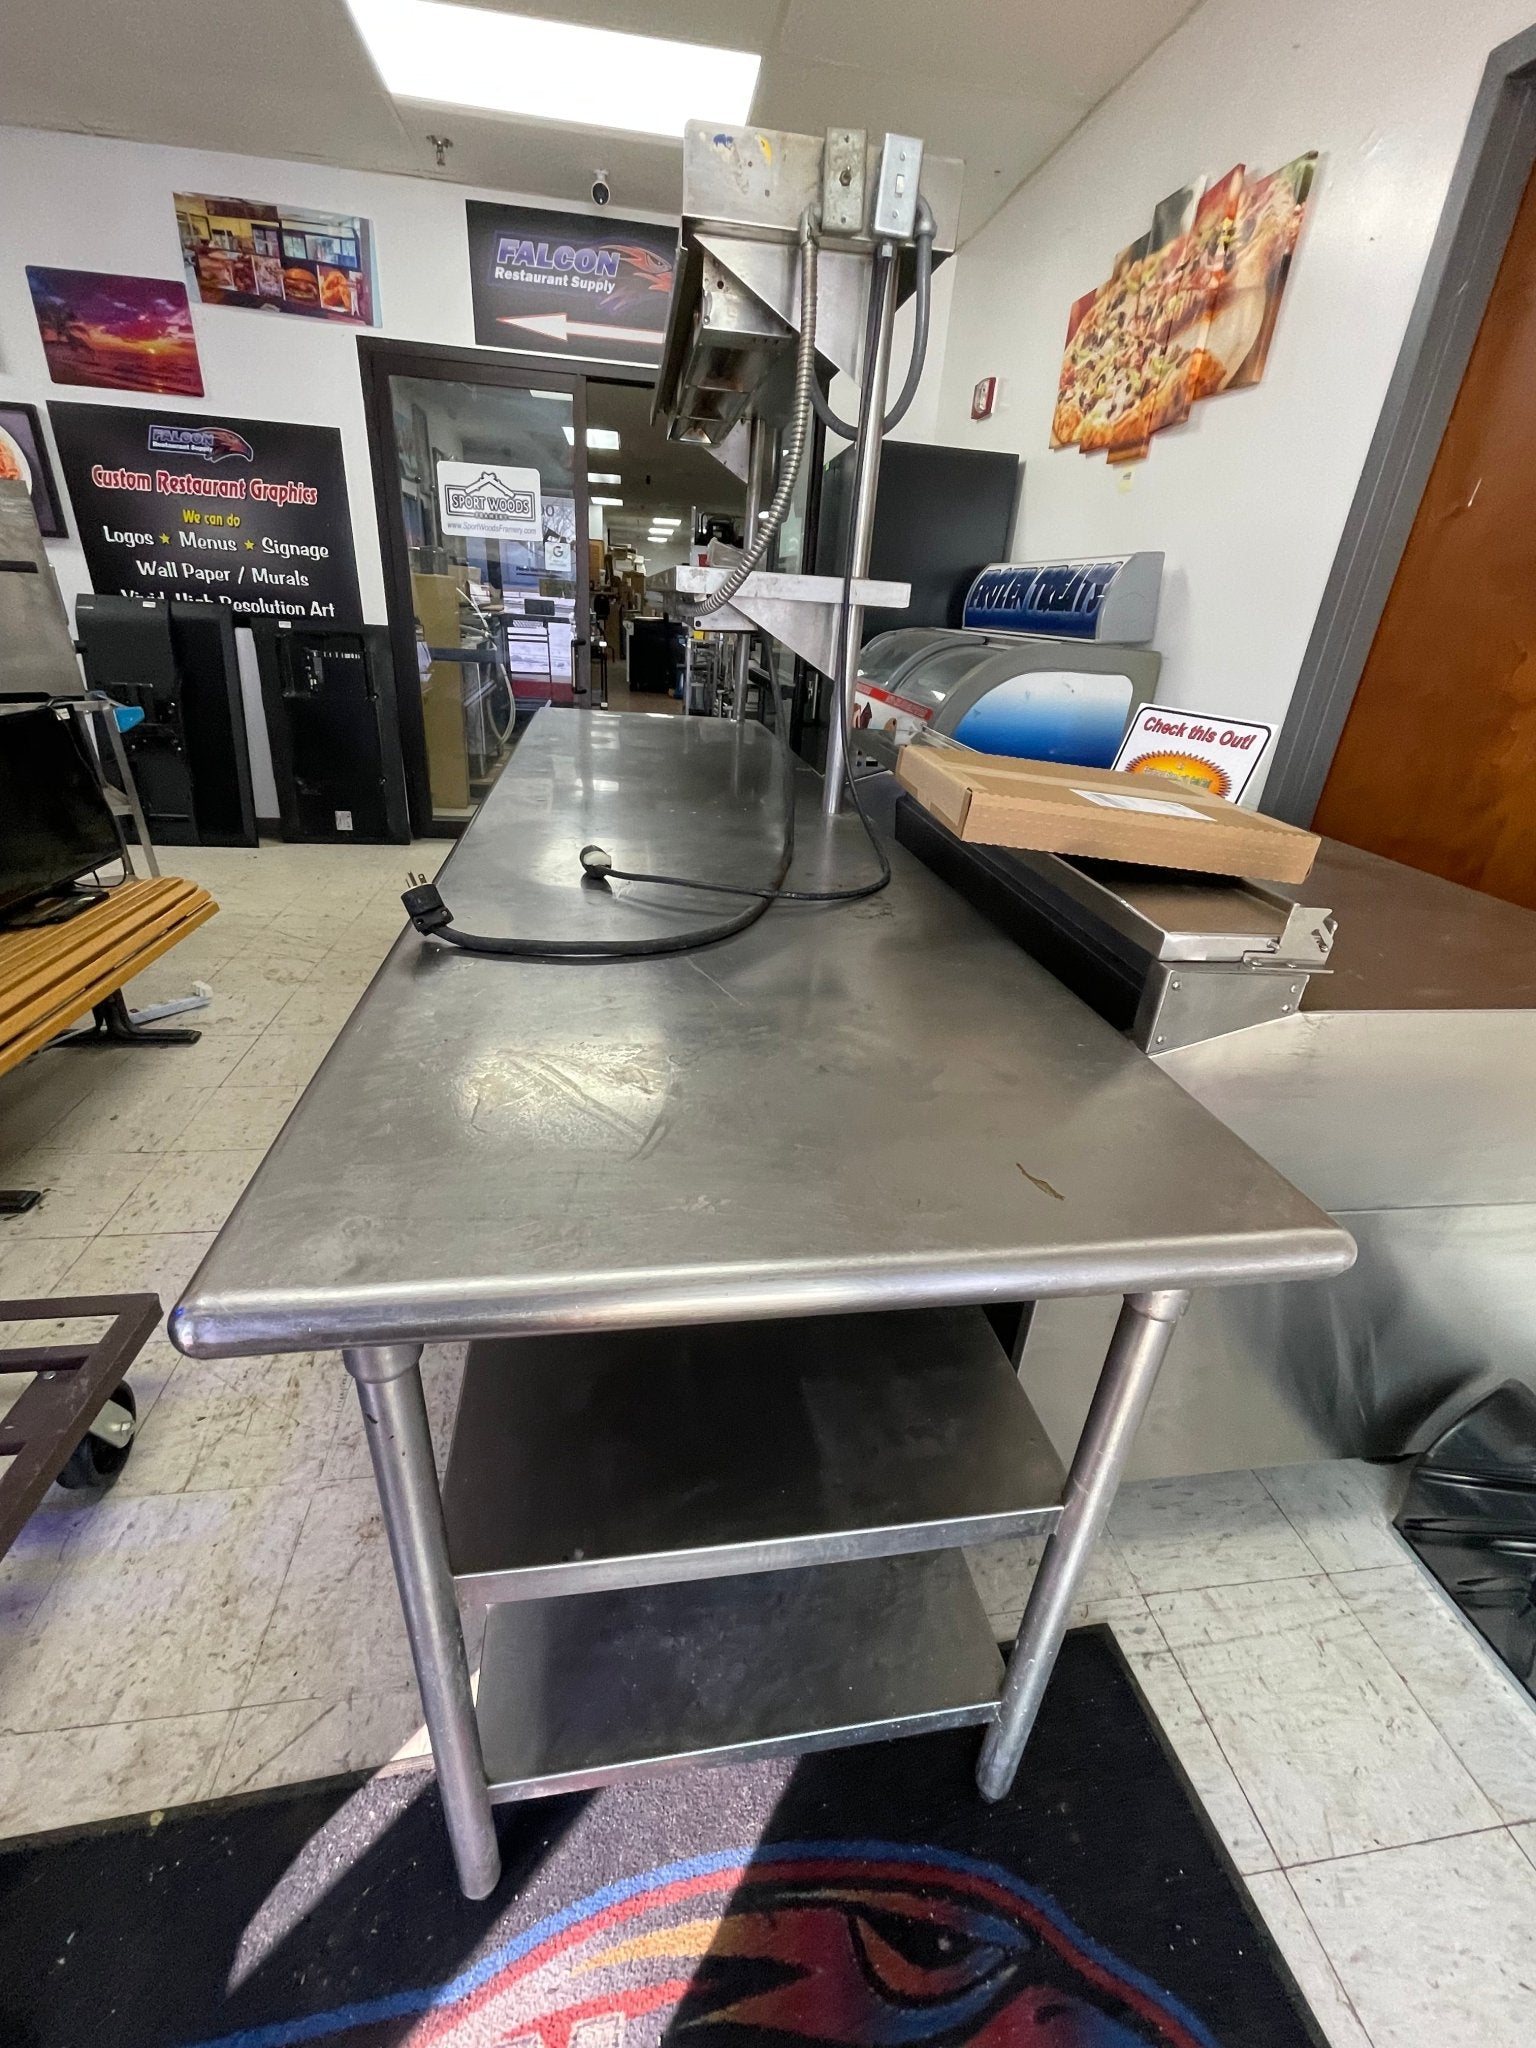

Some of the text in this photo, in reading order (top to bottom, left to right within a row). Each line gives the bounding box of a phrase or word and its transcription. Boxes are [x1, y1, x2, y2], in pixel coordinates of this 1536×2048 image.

[497, 238, 621, 278] FALCON
[494, 266, 616, 295] Restaurant Supply
[152, 428, 214, 447] FALCON
[92, 465, 318, 507] Custom Restaurant Graphics
[451, 494, 530, 514] SPORT WOODS
[182, 508, 241, 528] We can do
[447, 522, 537, 536] www.SportWoodsFramery.com
[102, 525, 330, 561] Logos Menus Signage
[136, 560, 310, 587] Wall Paper / Murals
[309, 601, 335, 618] Art
[1143, 716, 1258, 750] Check this Out!
